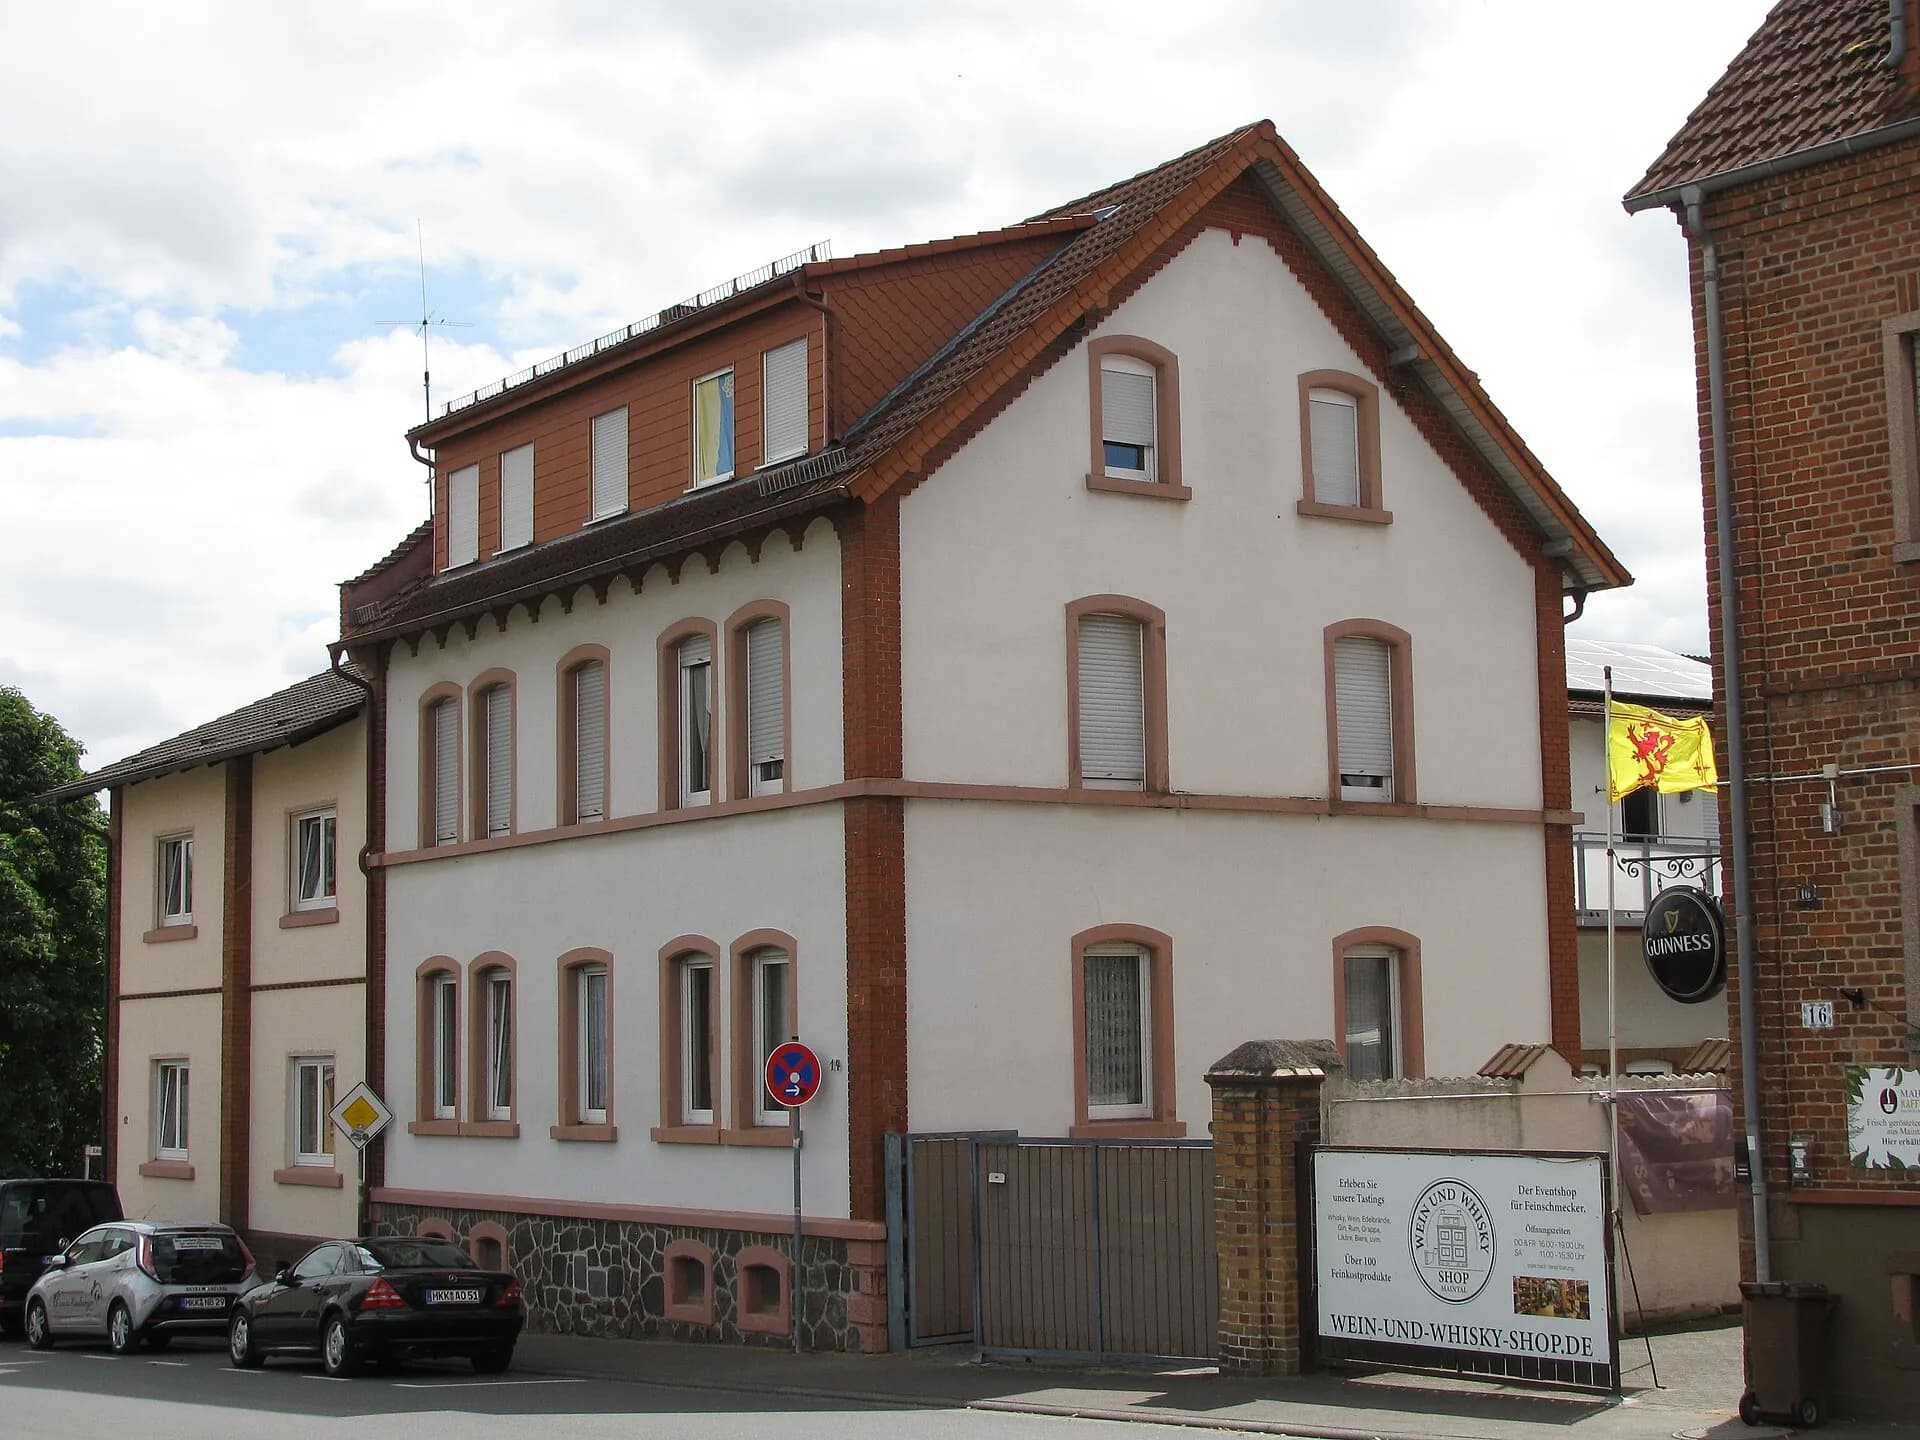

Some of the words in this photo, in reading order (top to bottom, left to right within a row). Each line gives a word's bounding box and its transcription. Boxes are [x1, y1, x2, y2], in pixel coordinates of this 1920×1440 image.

[1801, 888, 1811, 900] 16
[1646, 934, 1712, 956] GUINNESS
[1808, 1007, 1827, 1026] 16
[1881, 1137, 1897, 1145] Hier
[1339, 1178, 1366, 1189] Erleben
[1367, 1179, 1378, 1189] Sie
[1518, 1185, 1533, 1195] Der
[1535, 1186, 1577, 1199] Eventshop
[1332, 1194, 1355, 1203] unsere
[1356, 1193, 1385, 1207] Tastings
[1510, 1200, 1522, 1210] für
[1524, 1200, 1586, 1213] Feinschmecker.
[1415, 1204, 1431, 1250] WEIN
[1428, 1188, 1456, 1206] UND
[1460, 1191, 1490, 1254] WHISKY
[1525, 1224, 1571, 1236] Öffnungszeiten
[1344, 1253, 1362, 1265] Über
[1364, 1256, 1377, 1266] 100
[1514, 1249, 1522, 1257] SA
[1331, 1268, 1392, 1282] Feinkostprodukte
[1438, 1270, 1469, 1284] SHOP
[468, 1290, 479, 1301] 51
[1441, 1285, 1467, 1293] MAINTAL
[215, 1297, 225, 1306] 29
[1331, 1314, 1594, 1356] WEIN-UND-WHISKY-SHOP.DE
